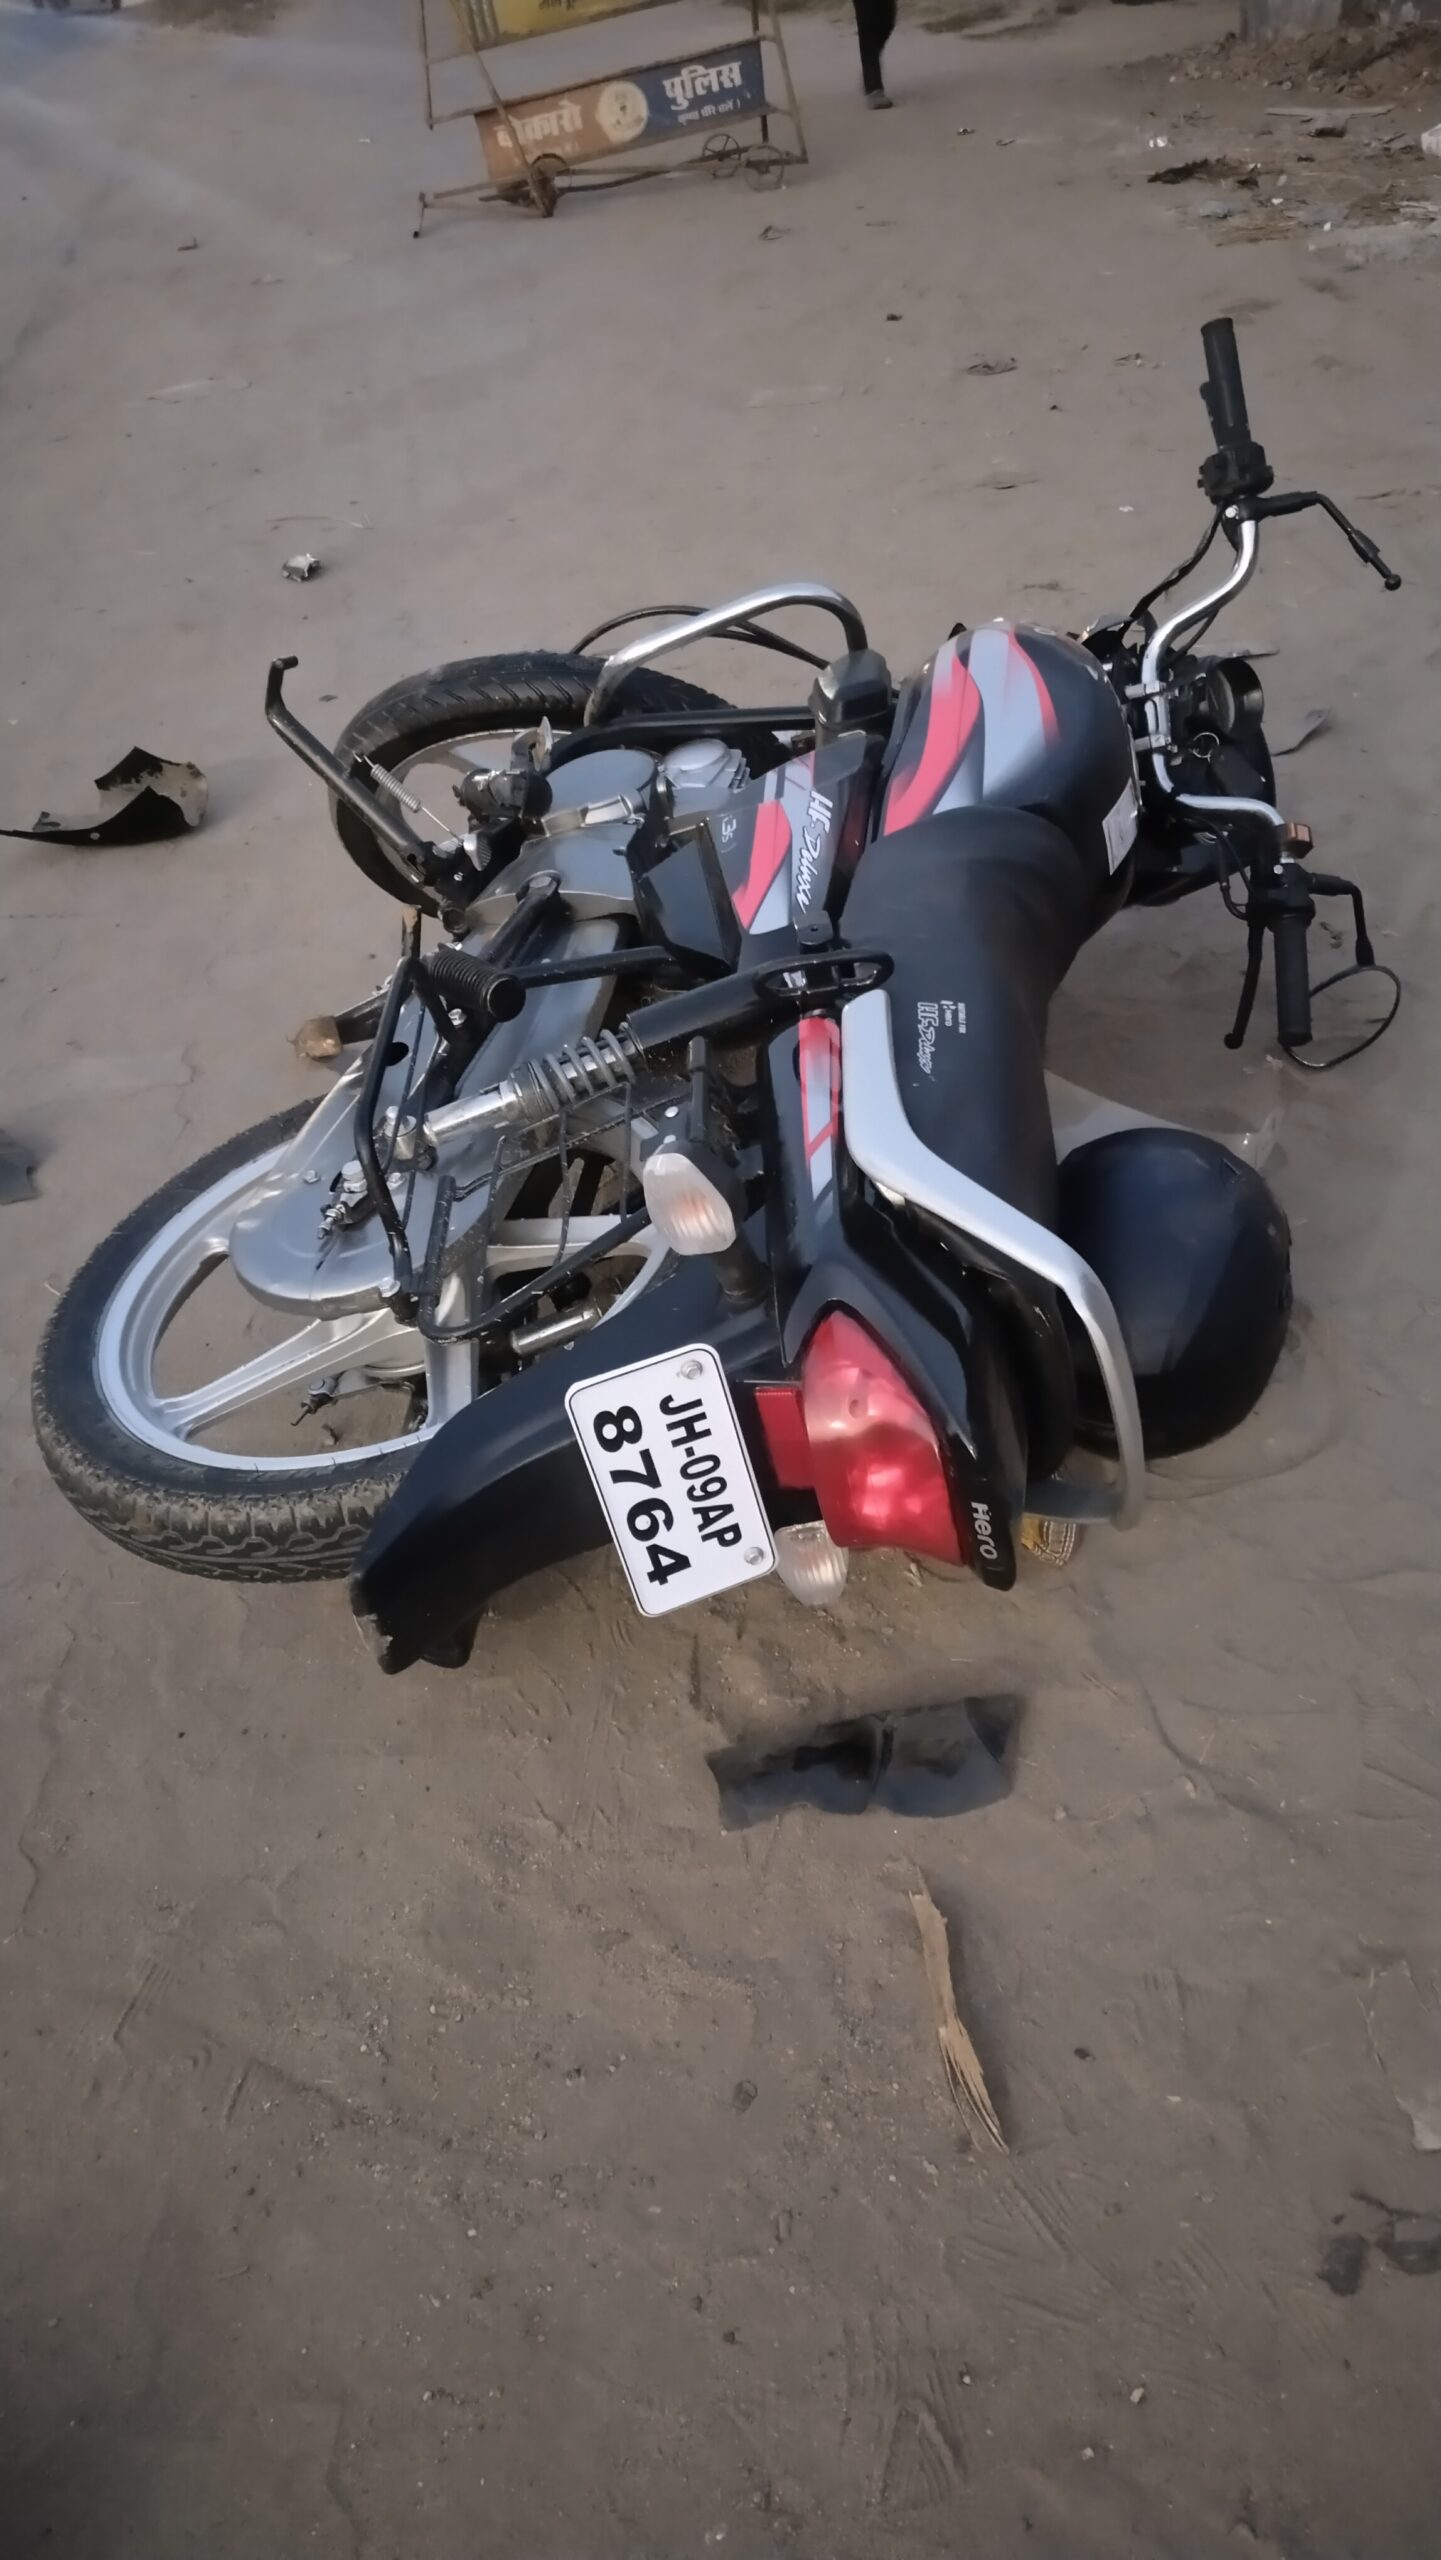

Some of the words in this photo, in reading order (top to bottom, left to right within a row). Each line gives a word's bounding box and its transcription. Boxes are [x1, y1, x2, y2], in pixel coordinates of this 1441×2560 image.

[662, 61, 742, 110] पुलिस
[796, 827, 821, 914] Deluxe
[593, 1405, 692, 1586] 8764
[659, 1394, 743, 1548] JH-09AP
[970, 1501, 998, 1560] Hero
